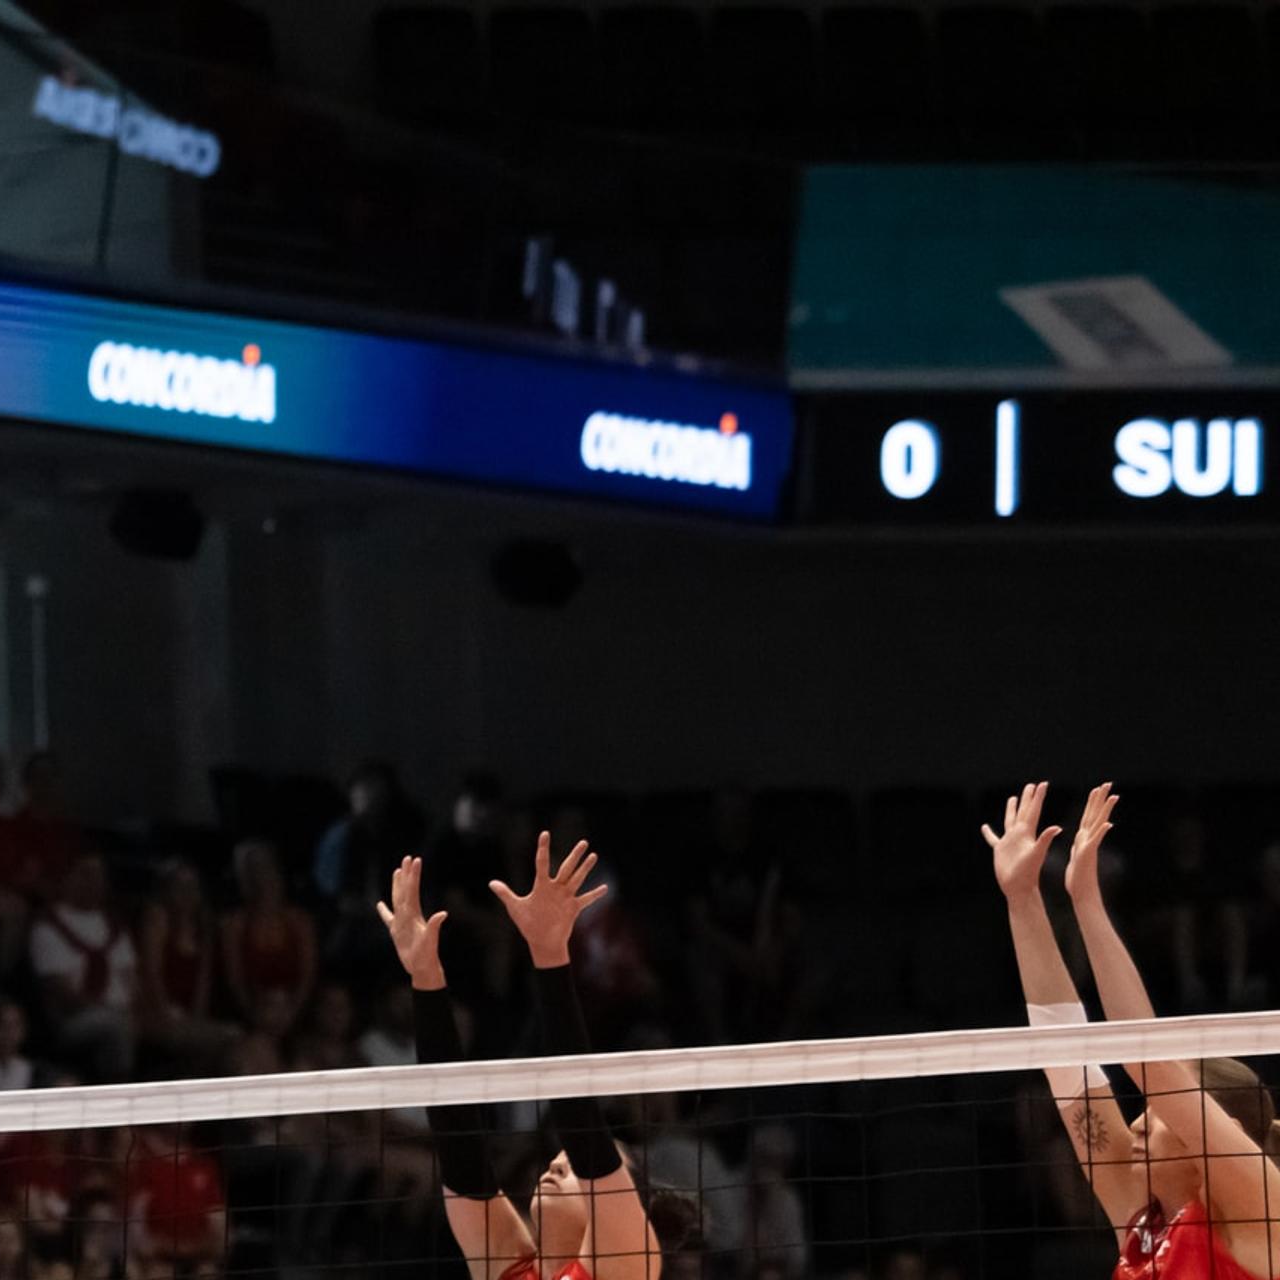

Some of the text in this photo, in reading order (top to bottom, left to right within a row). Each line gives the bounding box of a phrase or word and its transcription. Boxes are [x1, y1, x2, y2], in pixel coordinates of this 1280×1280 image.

[88, 340, 276, 423] CONCORDIA
[580, 411, 752, 491] CONCORDIA
[880, 418, 1263, 500] 0 SUI
